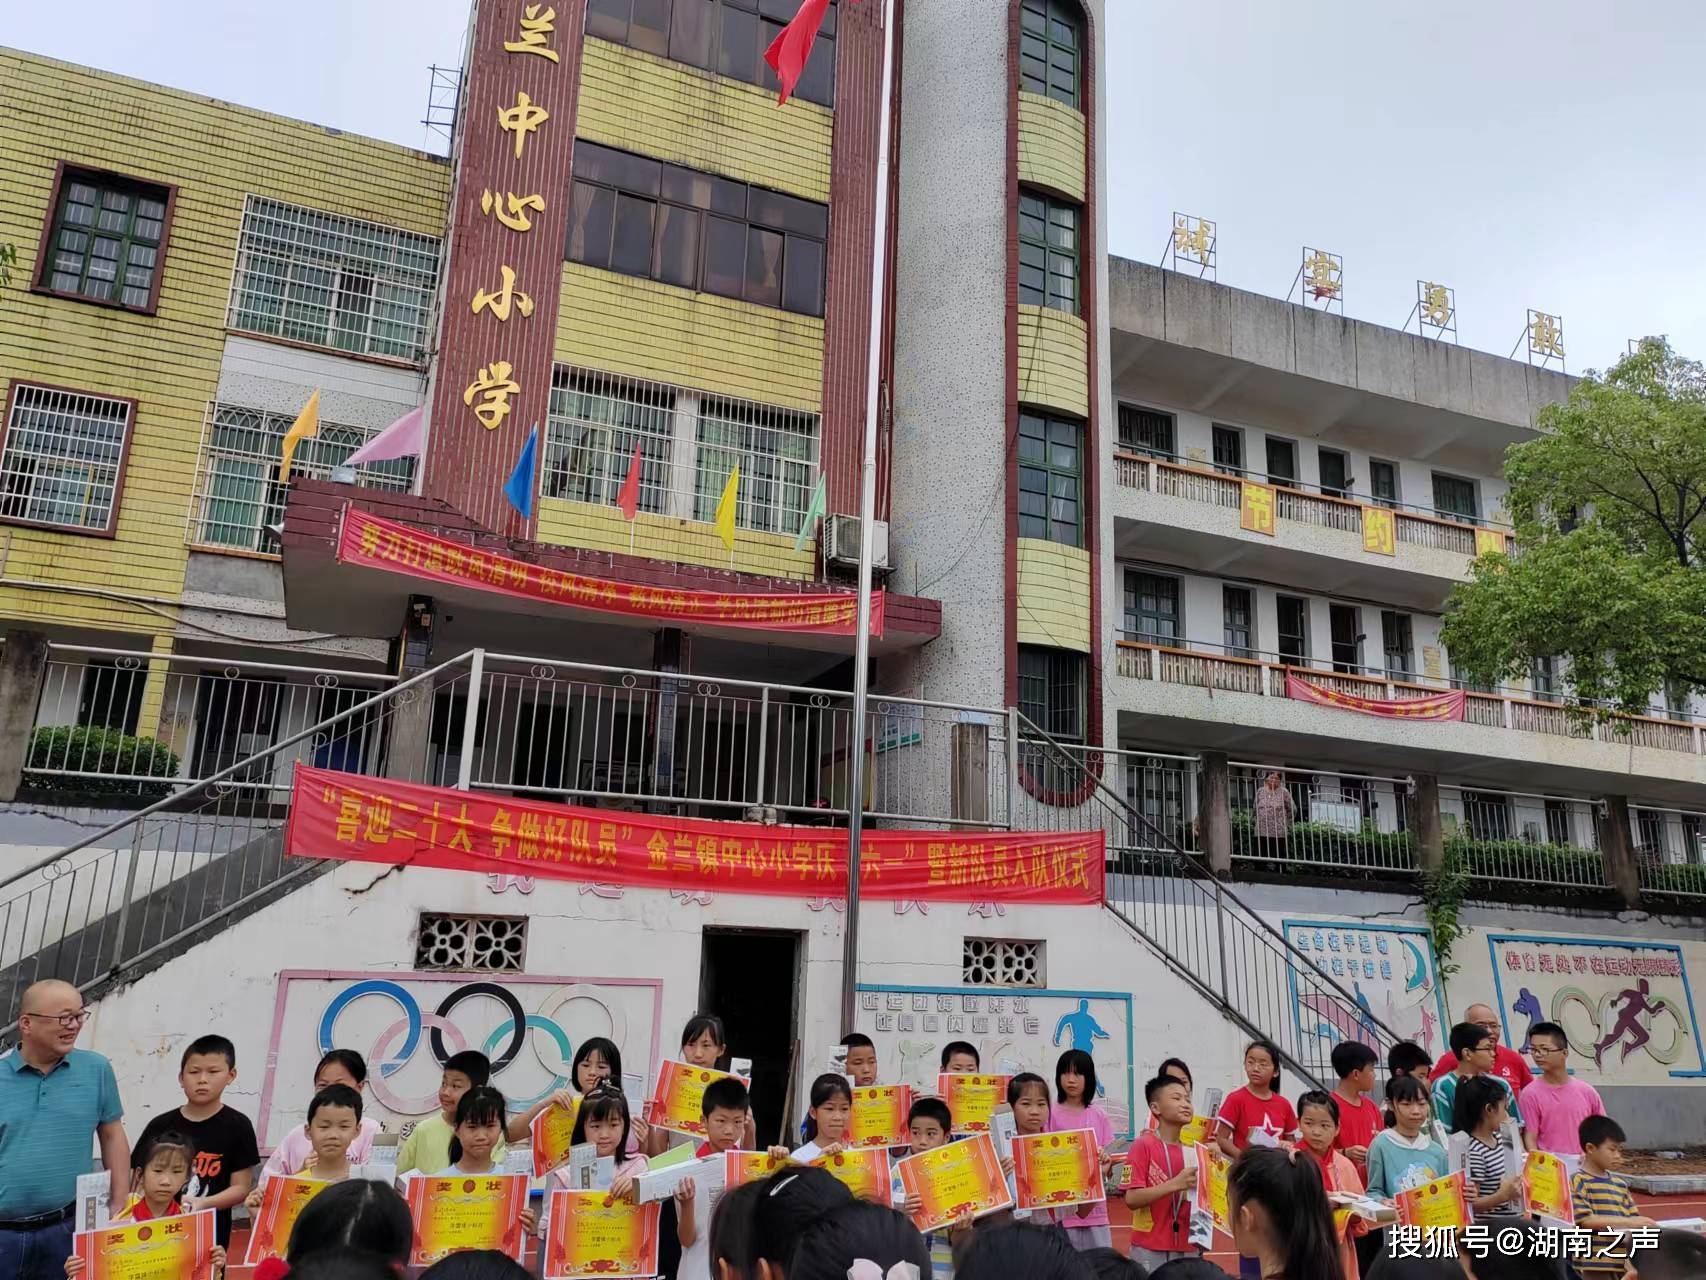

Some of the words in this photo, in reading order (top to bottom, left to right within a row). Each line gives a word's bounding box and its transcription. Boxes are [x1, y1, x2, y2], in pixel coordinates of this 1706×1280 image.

[464, 4, 559, 430] 兰中心小学
